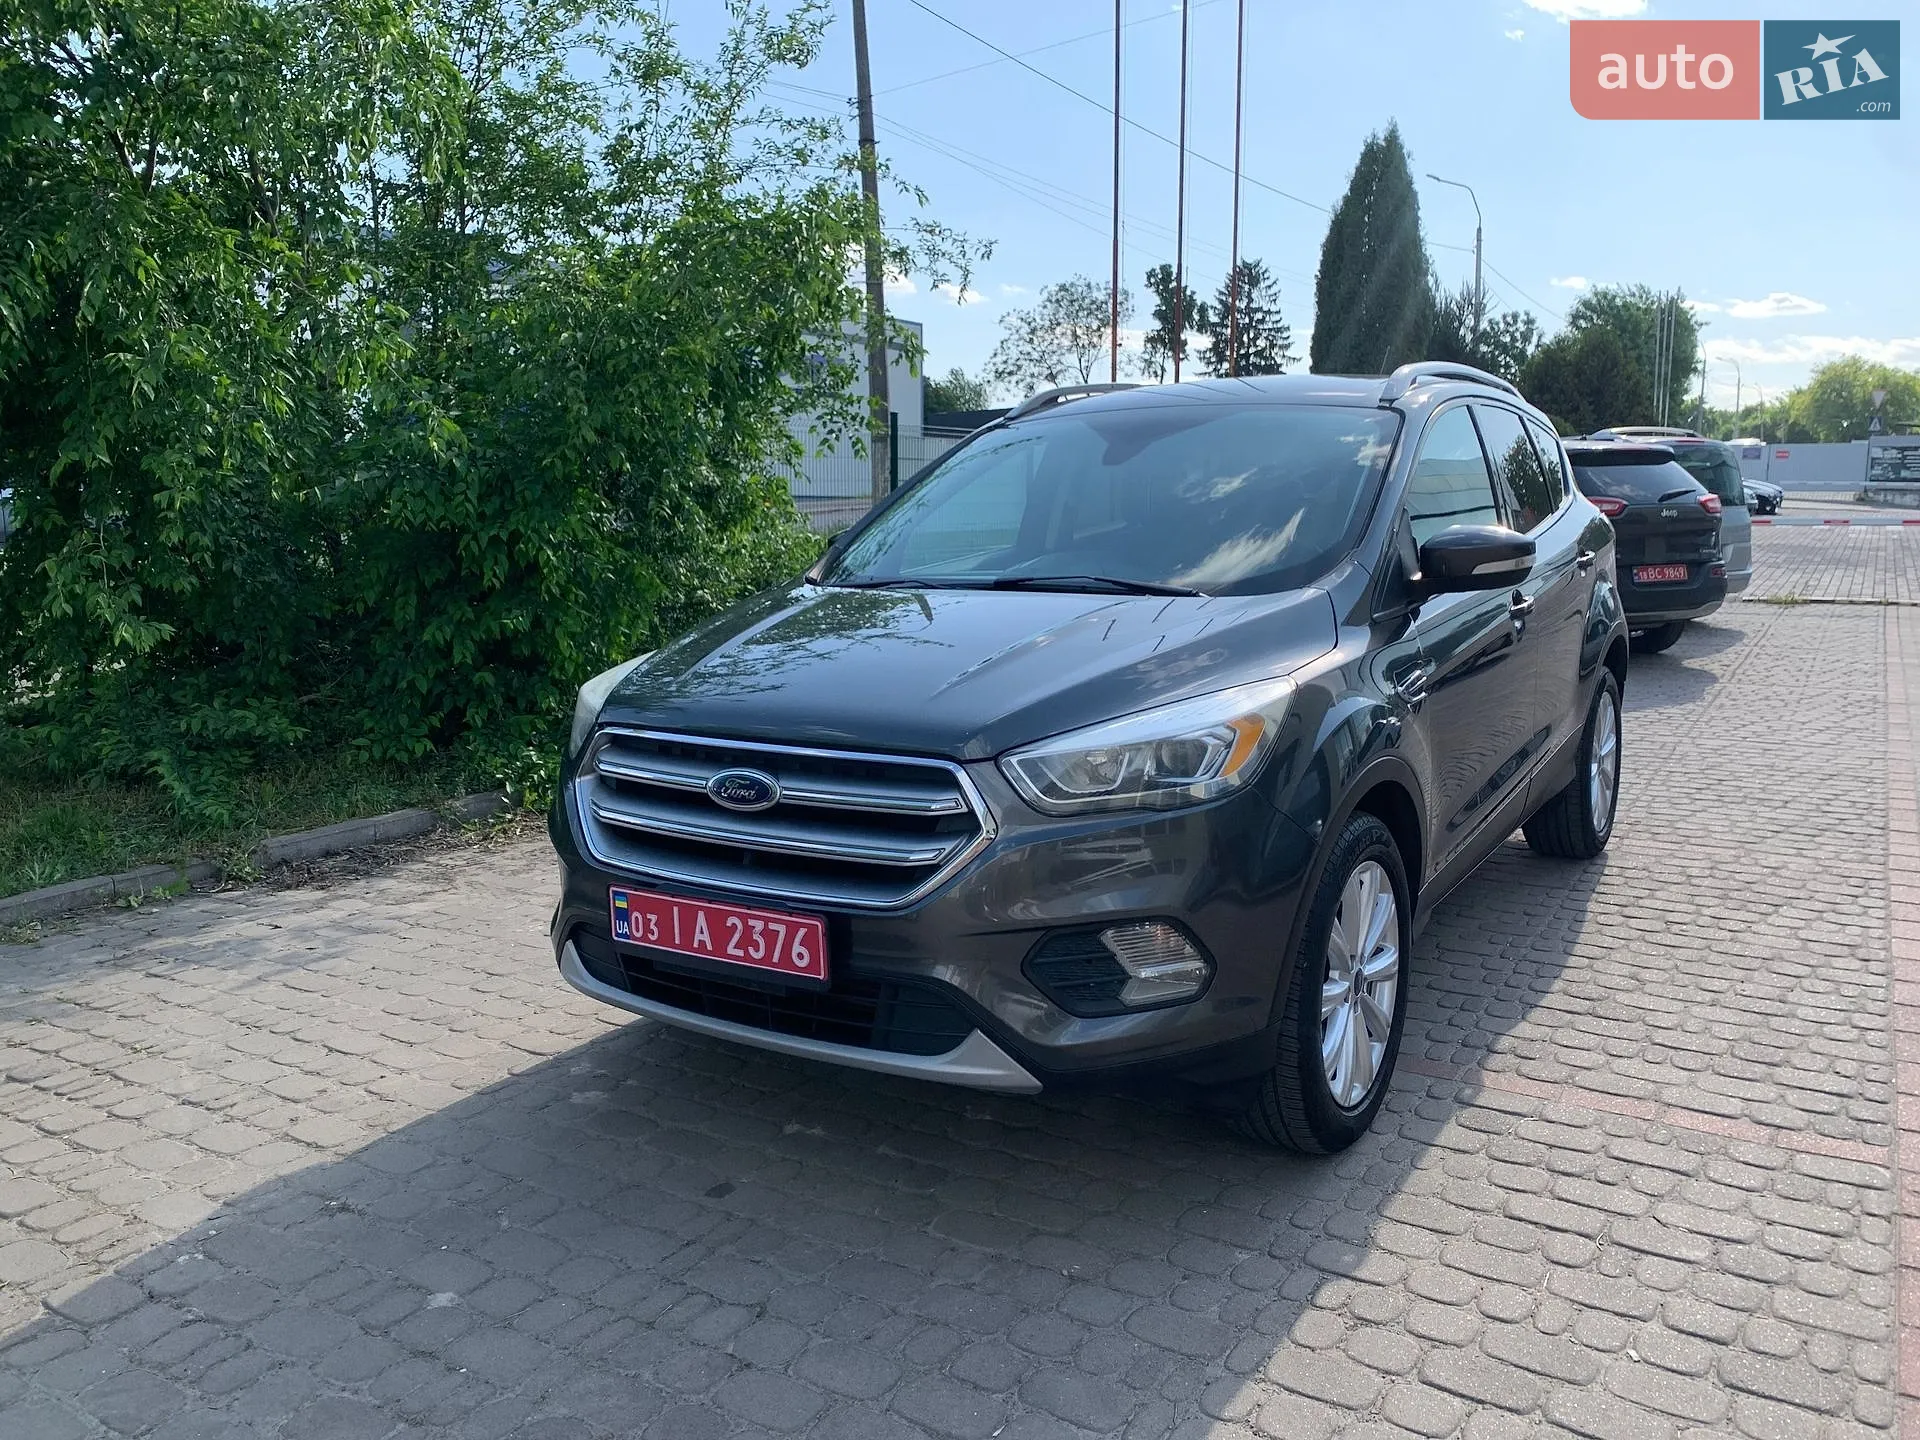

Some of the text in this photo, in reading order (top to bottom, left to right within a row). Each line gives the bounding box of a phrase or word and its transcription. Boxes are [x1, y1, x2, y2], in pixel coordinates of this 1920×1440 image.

[1660, 508, 1678, 518] Jeep
[1648, 567, 1662, 579] BC
[1663, 566, 1685, 578] 9849
[720, 777, 759, 801] Ford
[616, 920, 630, 936] UA
[631, 911, 659, 941] 03
[725, 916, 811, 968] 2376
